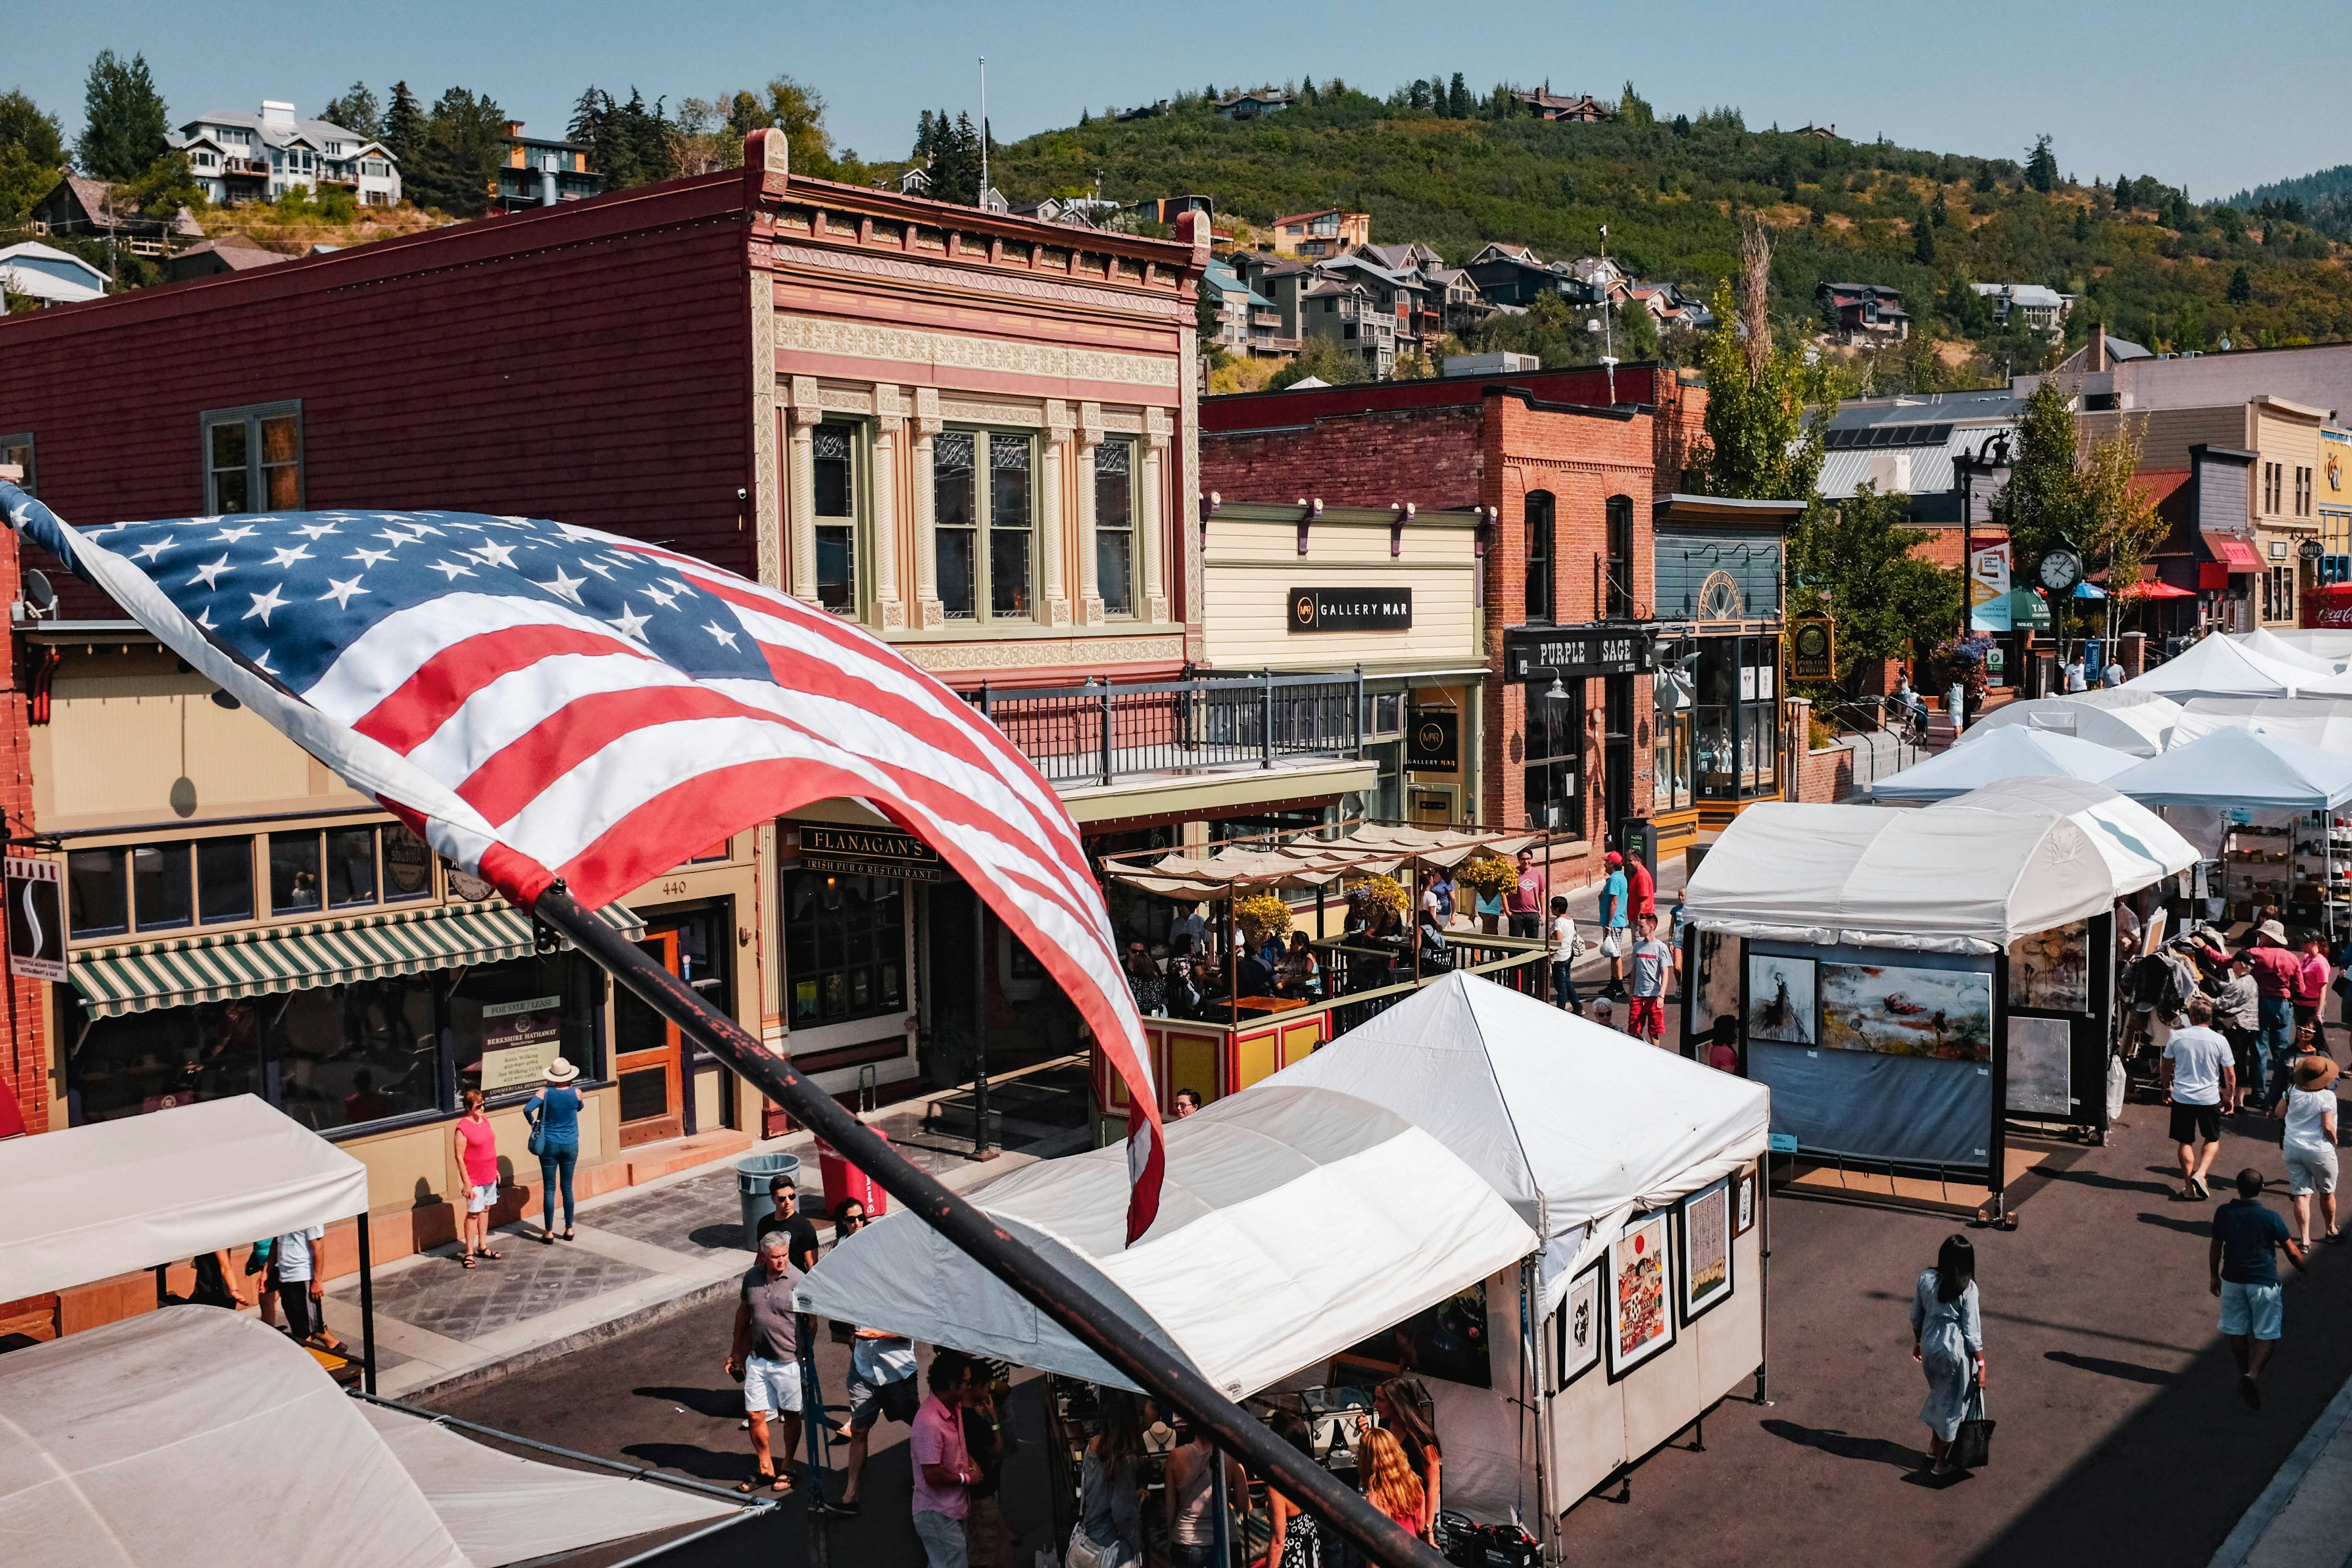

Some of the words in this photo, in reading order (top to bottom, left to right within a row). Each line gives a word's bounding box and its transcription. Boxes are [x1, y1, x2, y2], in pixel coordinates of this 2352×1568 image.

[2299, 546, 2323, 554] ROOTS
[1321, 604, 1377, 615] GALLERY
[1383, 603, 1407, 615] MAR
[1540, 641, 1585, 665] PURPLE
[1603, 639, 1630, 662] SAGE
[815, 832, 923, 856] FLANAGAN'S
[808, 860, 833, 870] IRISH
[837, 863, 855, 871] PUB
[868, 866, 932, 879] RESTAURANT
[663, 881, 686, 895] 440
[507, 1003, 527, 1012] SALE
[531, 999, 552, 1008] LEASE
[487, 1034, 524, 1045] BERKSHIRE
[525, 1029, 557, 1039] HATHAWAY
[490, 1085, 524, 1095] COMMERCIAL
[524, 1080, 548, 1089] DIVISION
